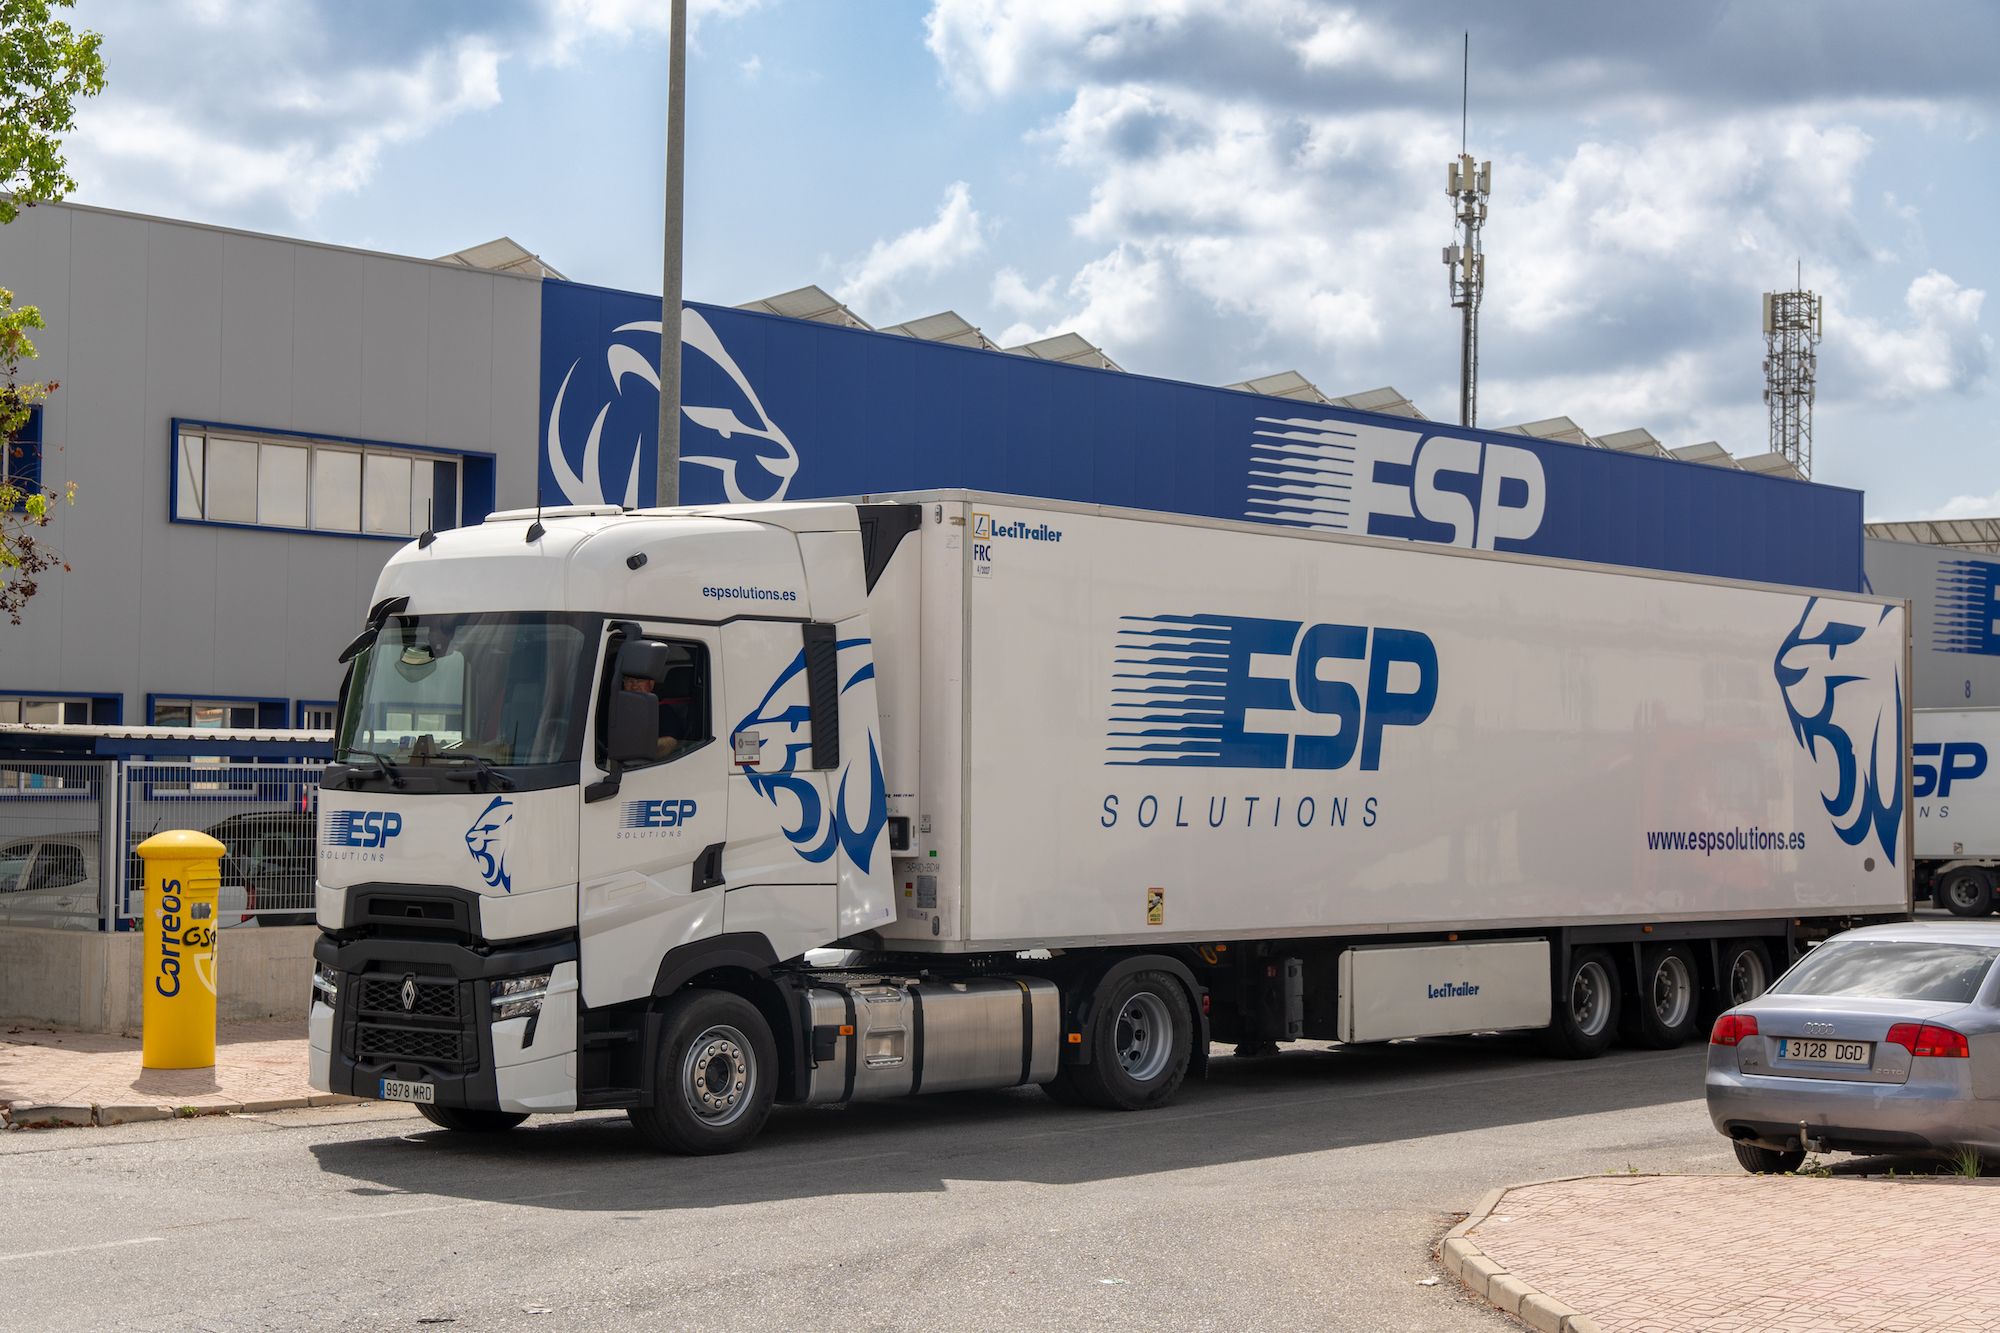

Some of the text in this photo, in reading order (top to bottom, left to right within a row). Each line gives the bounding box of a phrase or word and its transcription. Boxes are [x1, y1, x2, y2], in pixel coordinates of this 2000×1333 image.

[1346, 421, 1546, 550] ESP
[991, 519, 1062, 542] LeciTrailer
[974, 543, 991, 562] FRC
[702, 586, 796, 601] espsolutions.es
[1217, 613, 1439, 771] ESP
[1964, 679, 1972, 699] 8
[1912, 742, 1988, 798] SP
[643, 799, 697, 827] ESP
[1101, 794, 1379, 828] SOLUTIONS
[344, 810, 403, 849] ESP
[616, 831, 682, 840] SOLUTIONS
[1647, 826, 1806, 857] www.espsolutions.es
[320, 850, 385, 863] SOLUTIONS
[155, 878, 181, 998] Correos
[1428, 981, 1480, 999] LeciTrailer
[1792, 1042, 1863, 1061] 3128 DGD
[386, 1082, 432, 1101] 9978 MRD
